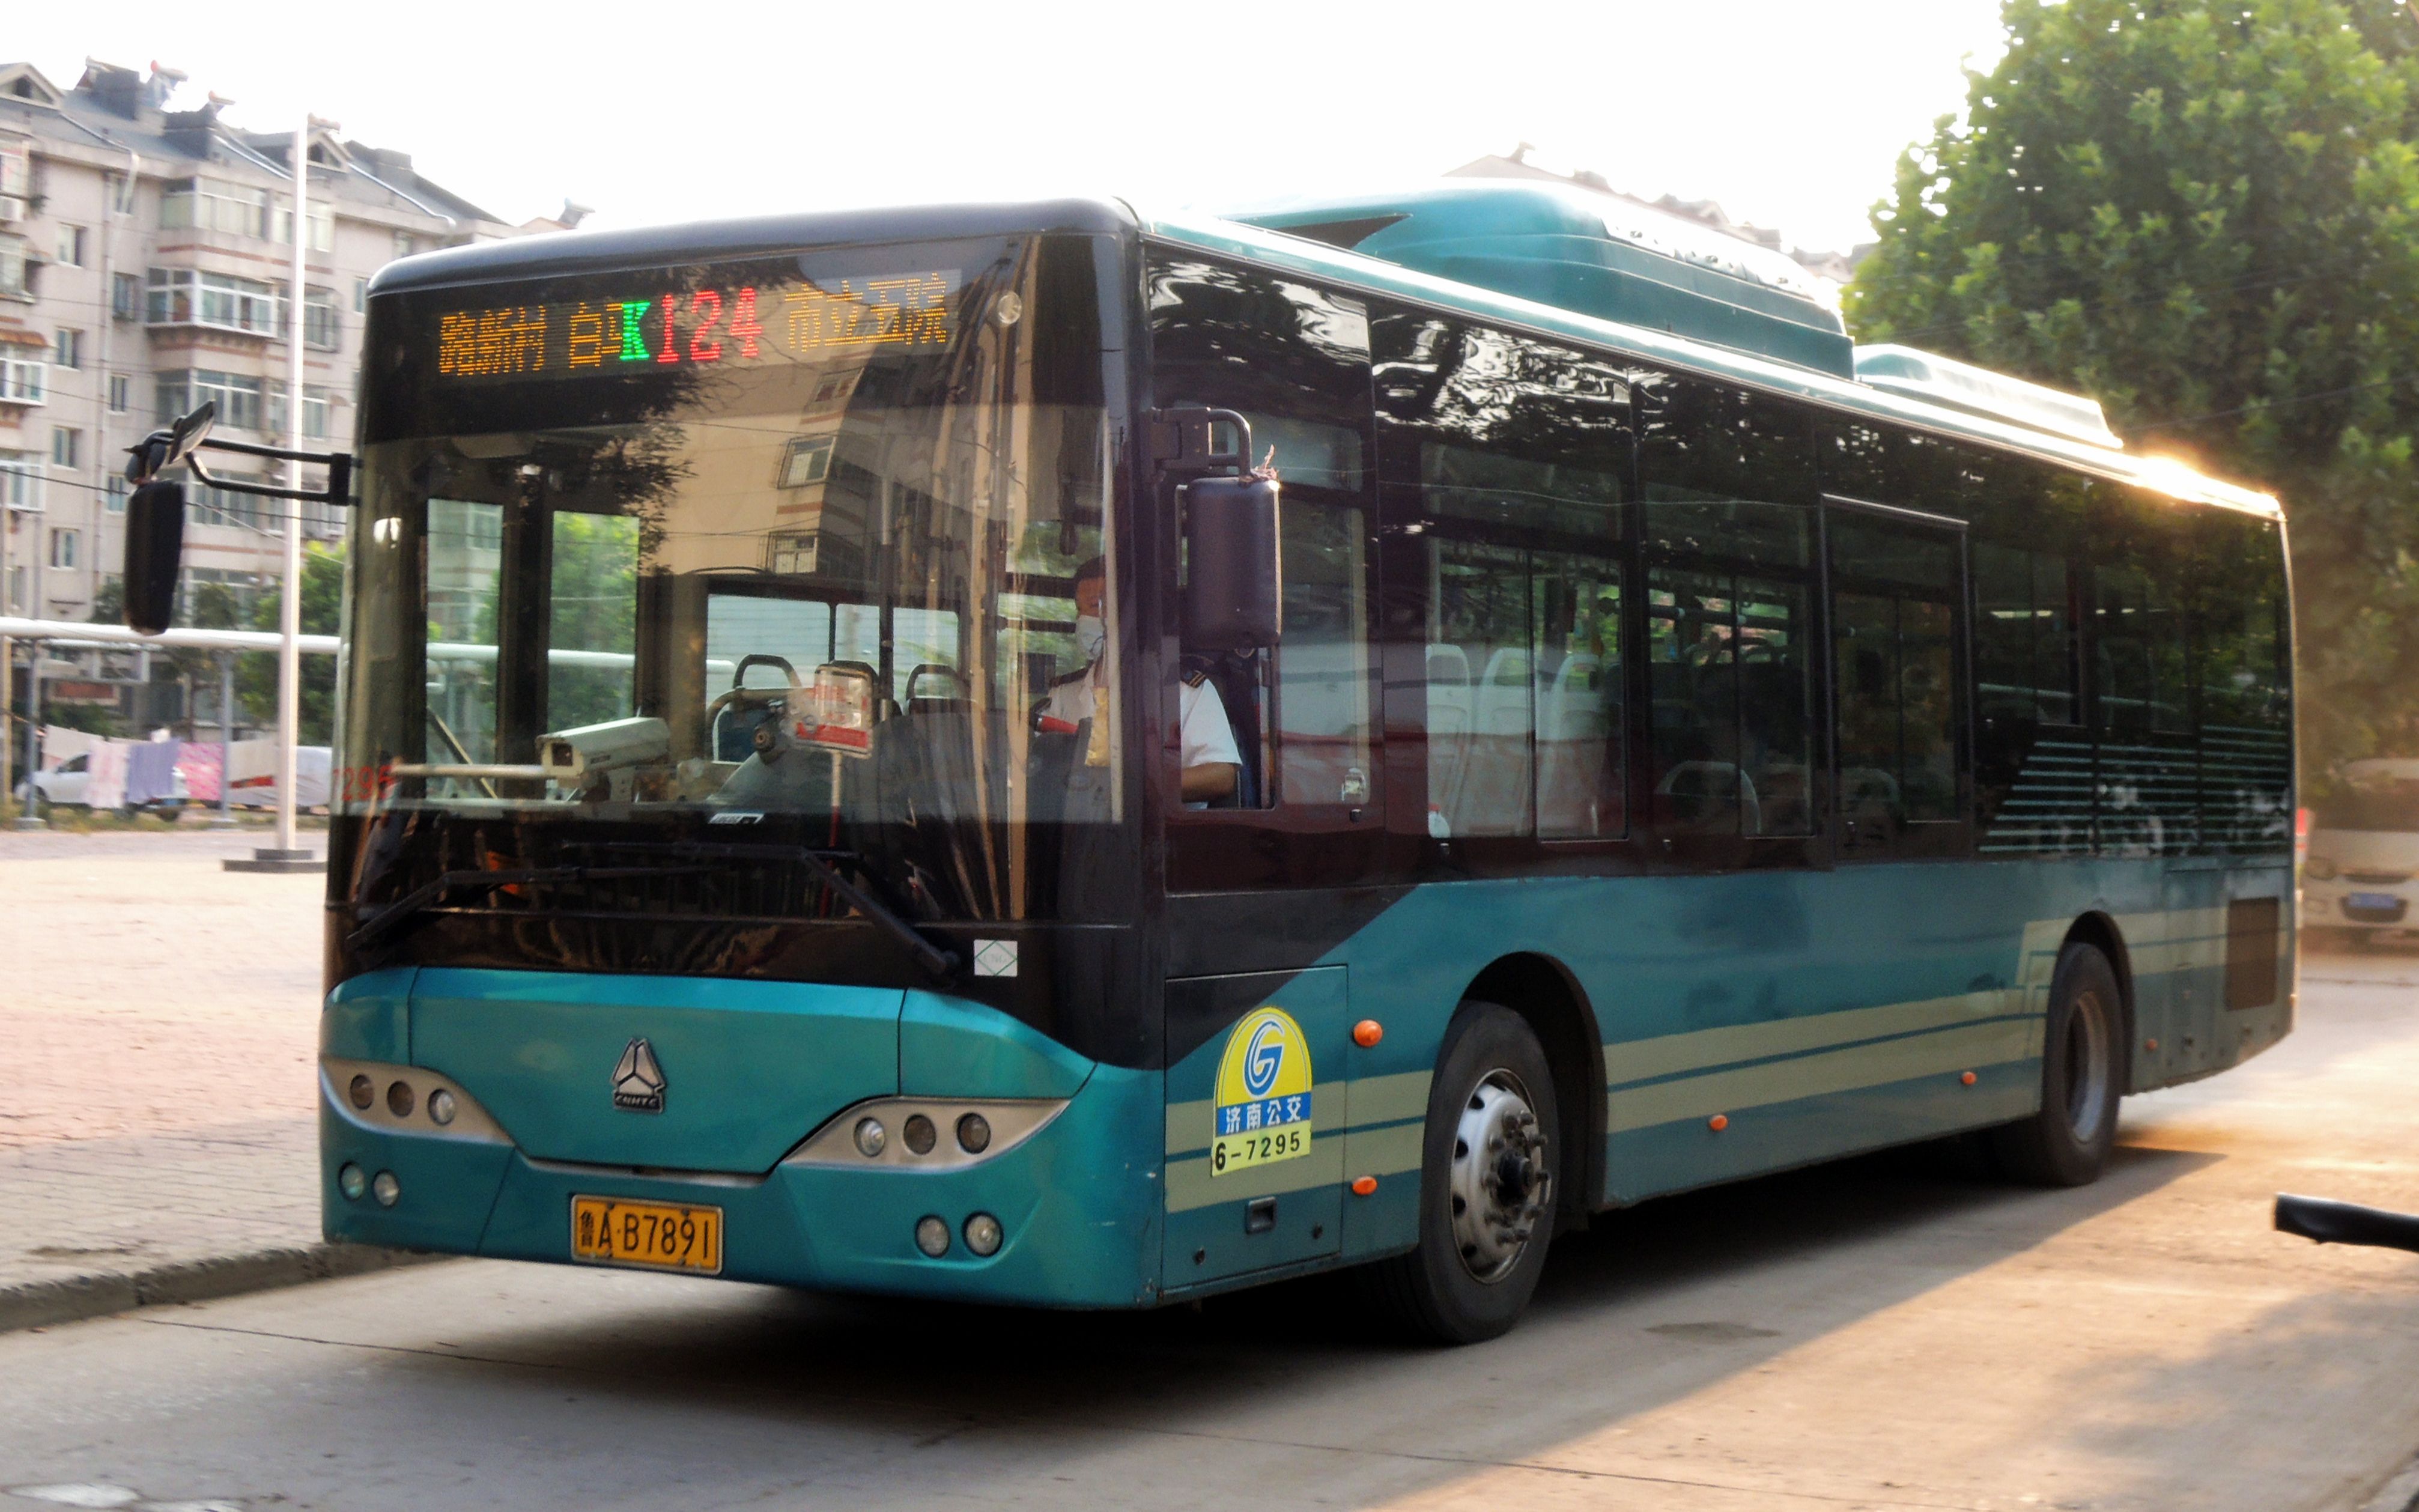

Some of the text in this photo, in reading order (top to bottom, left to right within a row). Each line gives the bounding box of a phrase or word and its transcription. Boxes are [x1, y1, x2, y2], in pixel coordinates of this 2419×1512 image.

[785, 272, 947, 352] 市立五院
[1225, 1096, 1302, 1134] 济南公交
[1215, 1131, 1301, 1171] 6-7295
